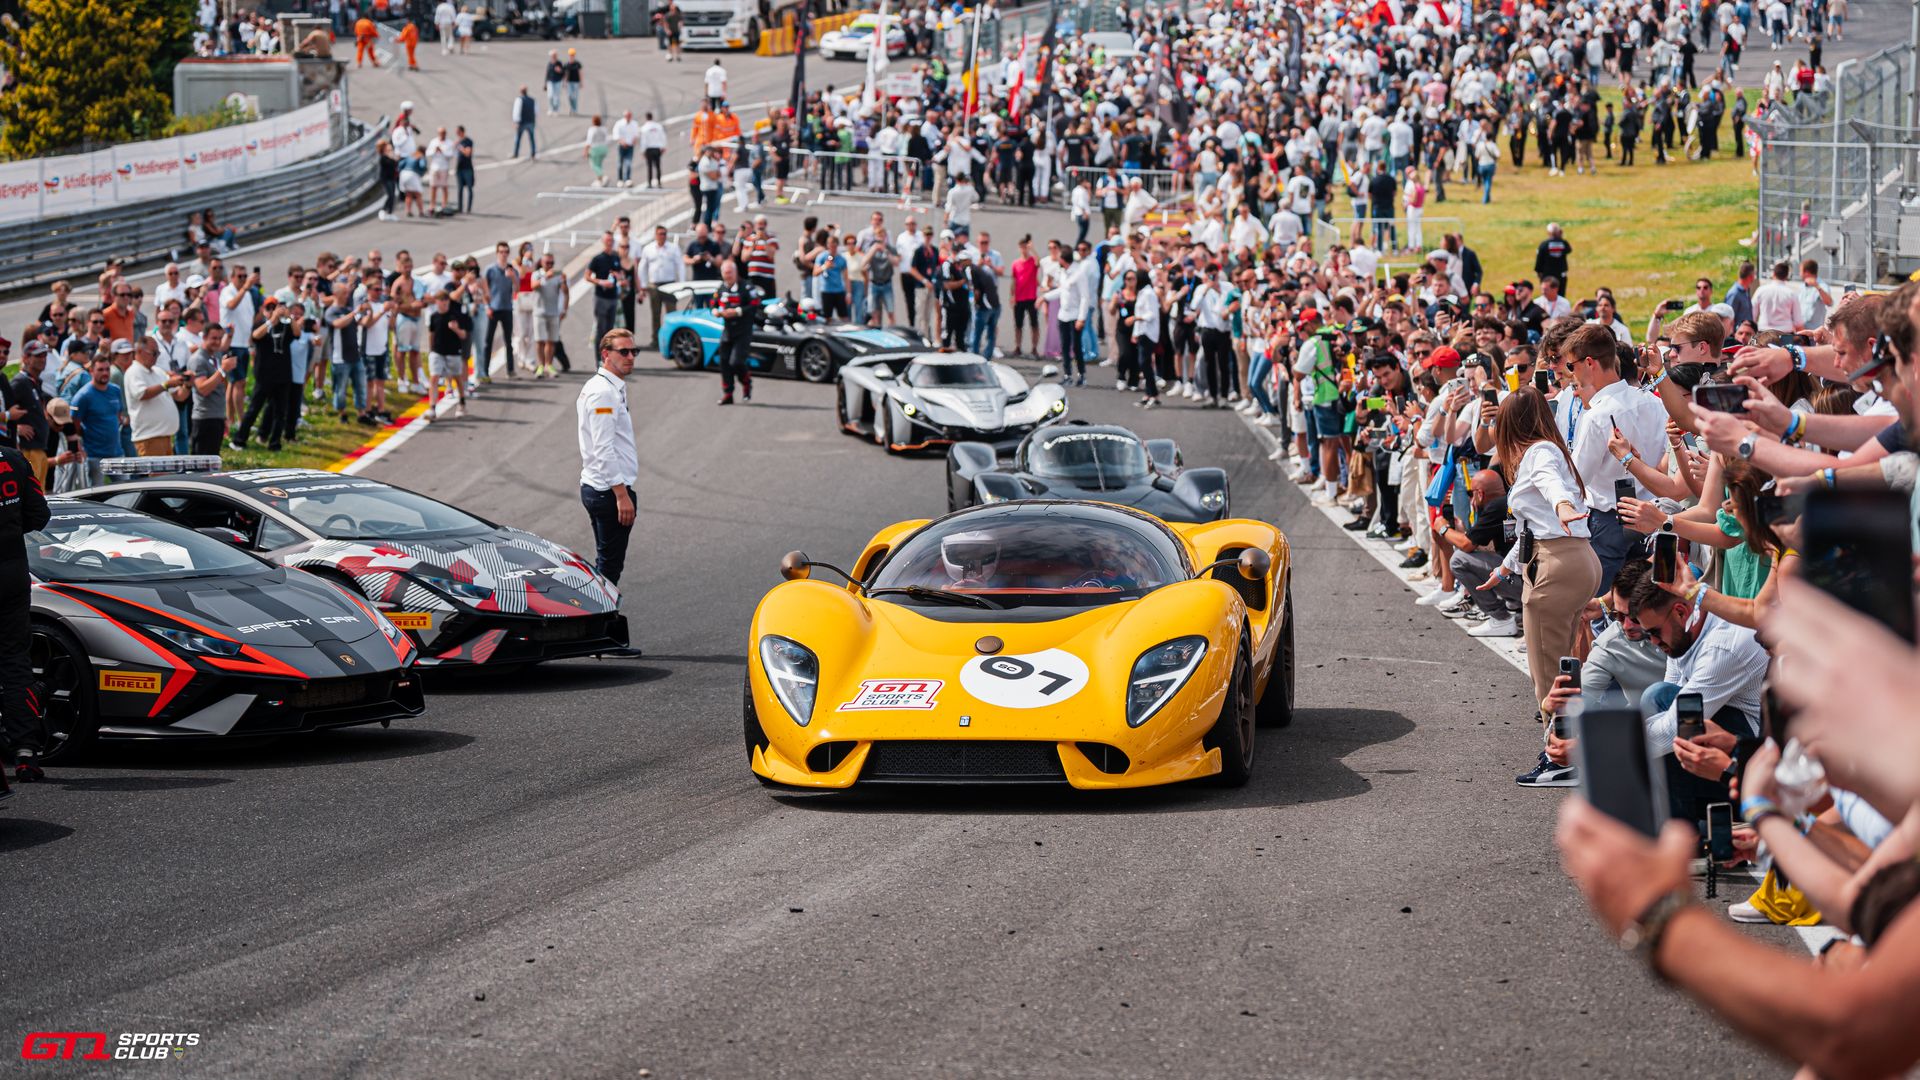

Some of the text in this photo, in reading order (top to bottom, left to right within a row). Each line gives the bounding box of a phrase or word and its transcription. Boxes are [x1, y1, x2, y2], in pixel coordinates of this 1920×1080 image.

[63, 170, 113, 188] TotalEnergies
[538, 567, 568, 575] CAR
[237, 616, 360, 634] SAFETY CAR
[104, 674, 156, 689] PIRELLI
[873, 683, 928, 693] GT1
